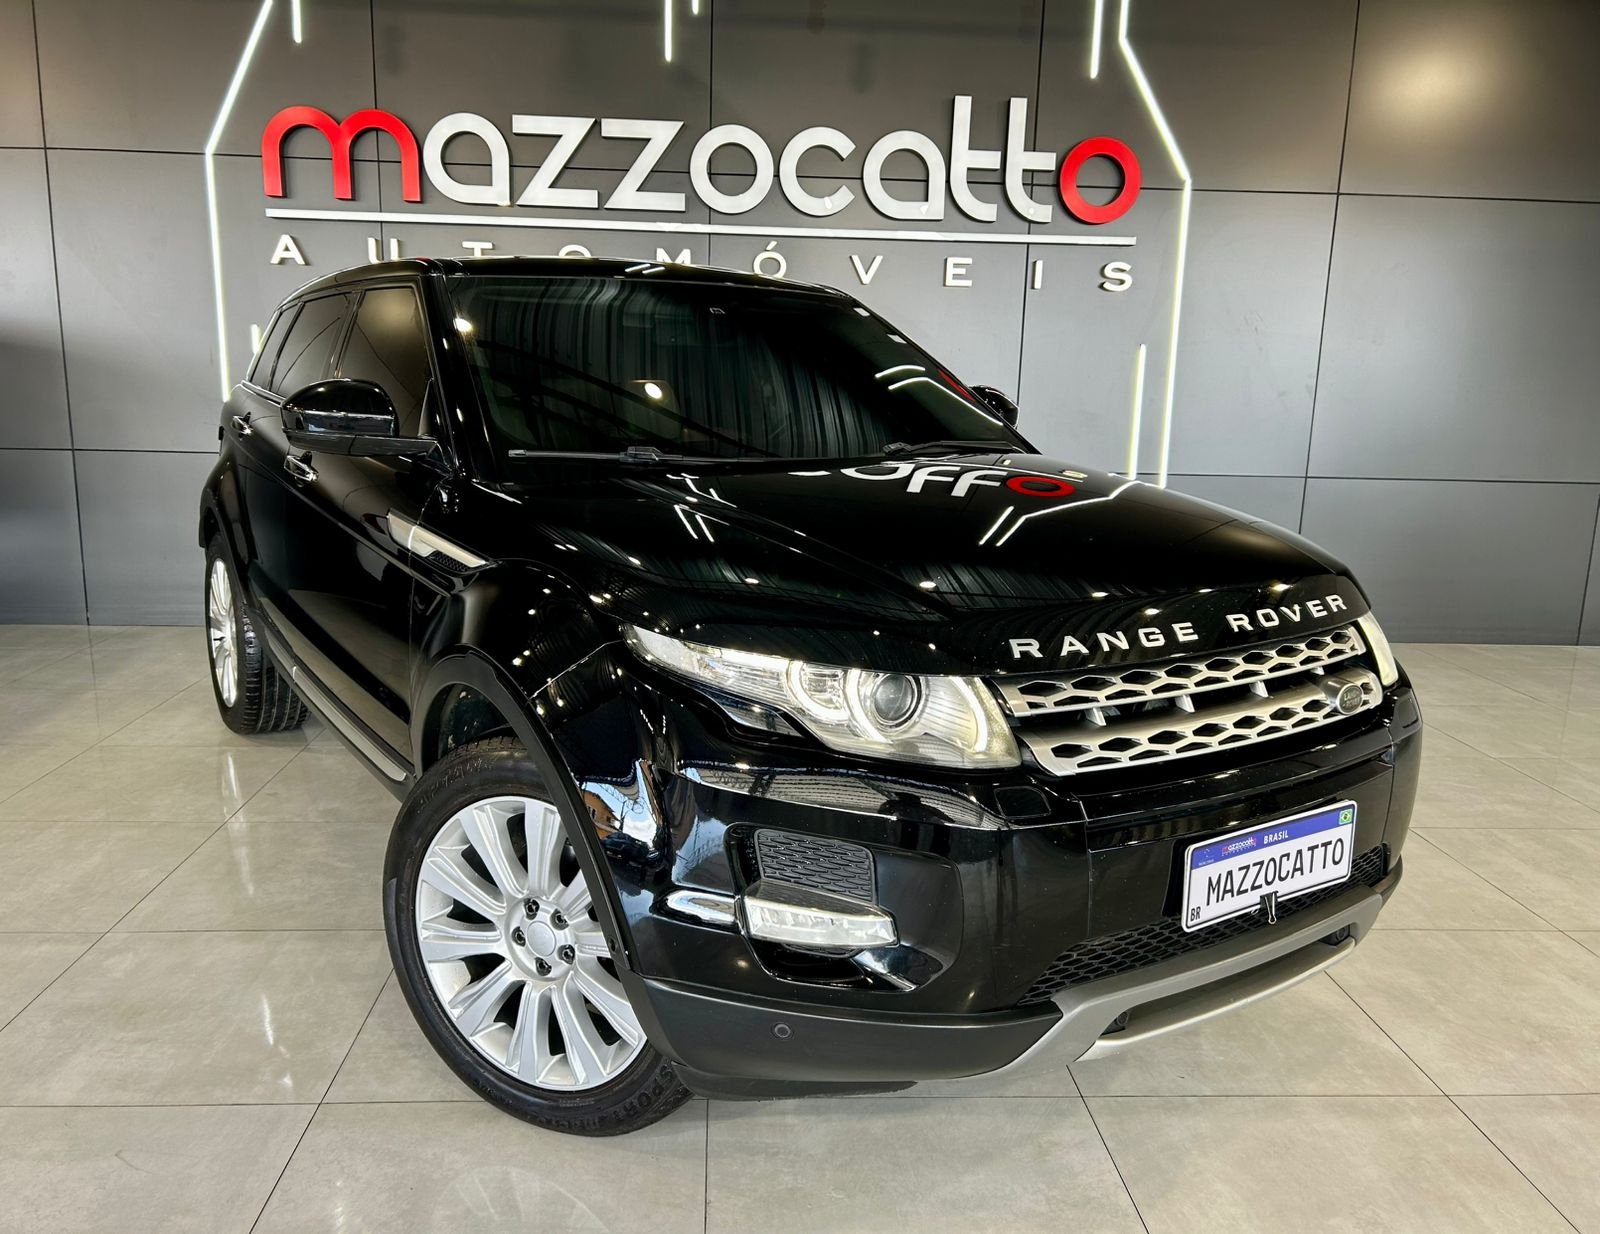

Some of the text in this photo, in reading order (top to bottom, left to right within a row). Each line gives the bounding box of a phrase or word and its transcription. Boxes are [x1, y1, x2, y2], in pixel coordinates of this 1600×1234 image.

[261, 95, 1143, 225] mazzocatto
[1009, 594, 1347, 660] RANGE ROVER
[1263, 831, 1289, 844] BRASIL
[1206, 838, 1344, 906] MAZZOCATTO
[1190, 906, 1201, 921] BR
